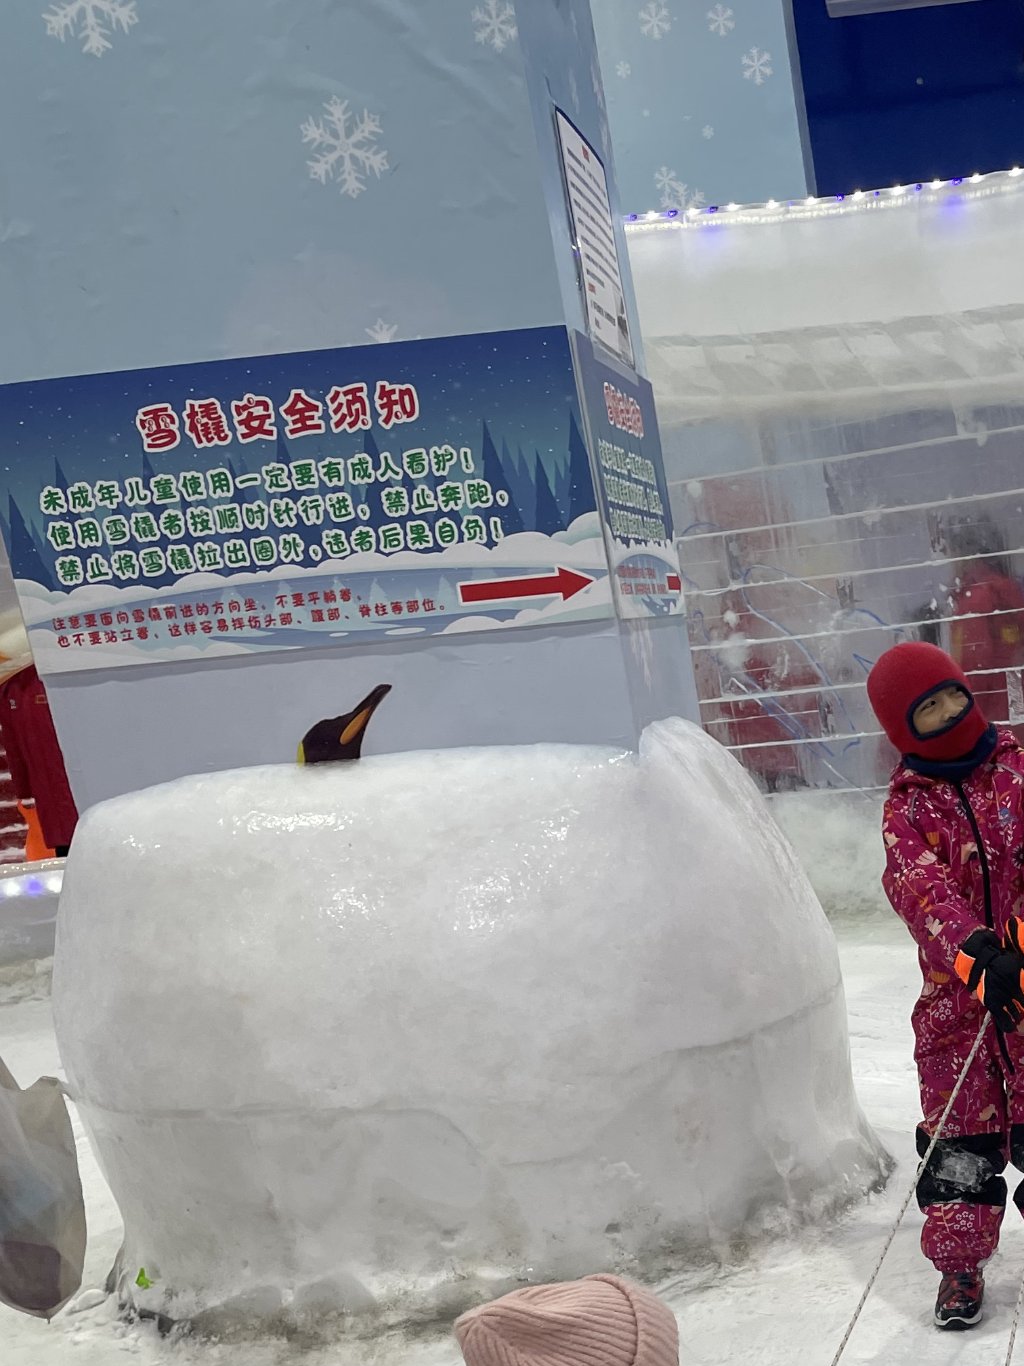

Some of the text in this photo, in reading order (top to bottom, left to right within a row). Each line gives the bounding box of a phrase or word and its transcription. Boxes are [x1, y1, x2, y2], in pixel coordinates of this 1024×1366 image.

[138, 382, 417, 450] 雪橇安全须知
